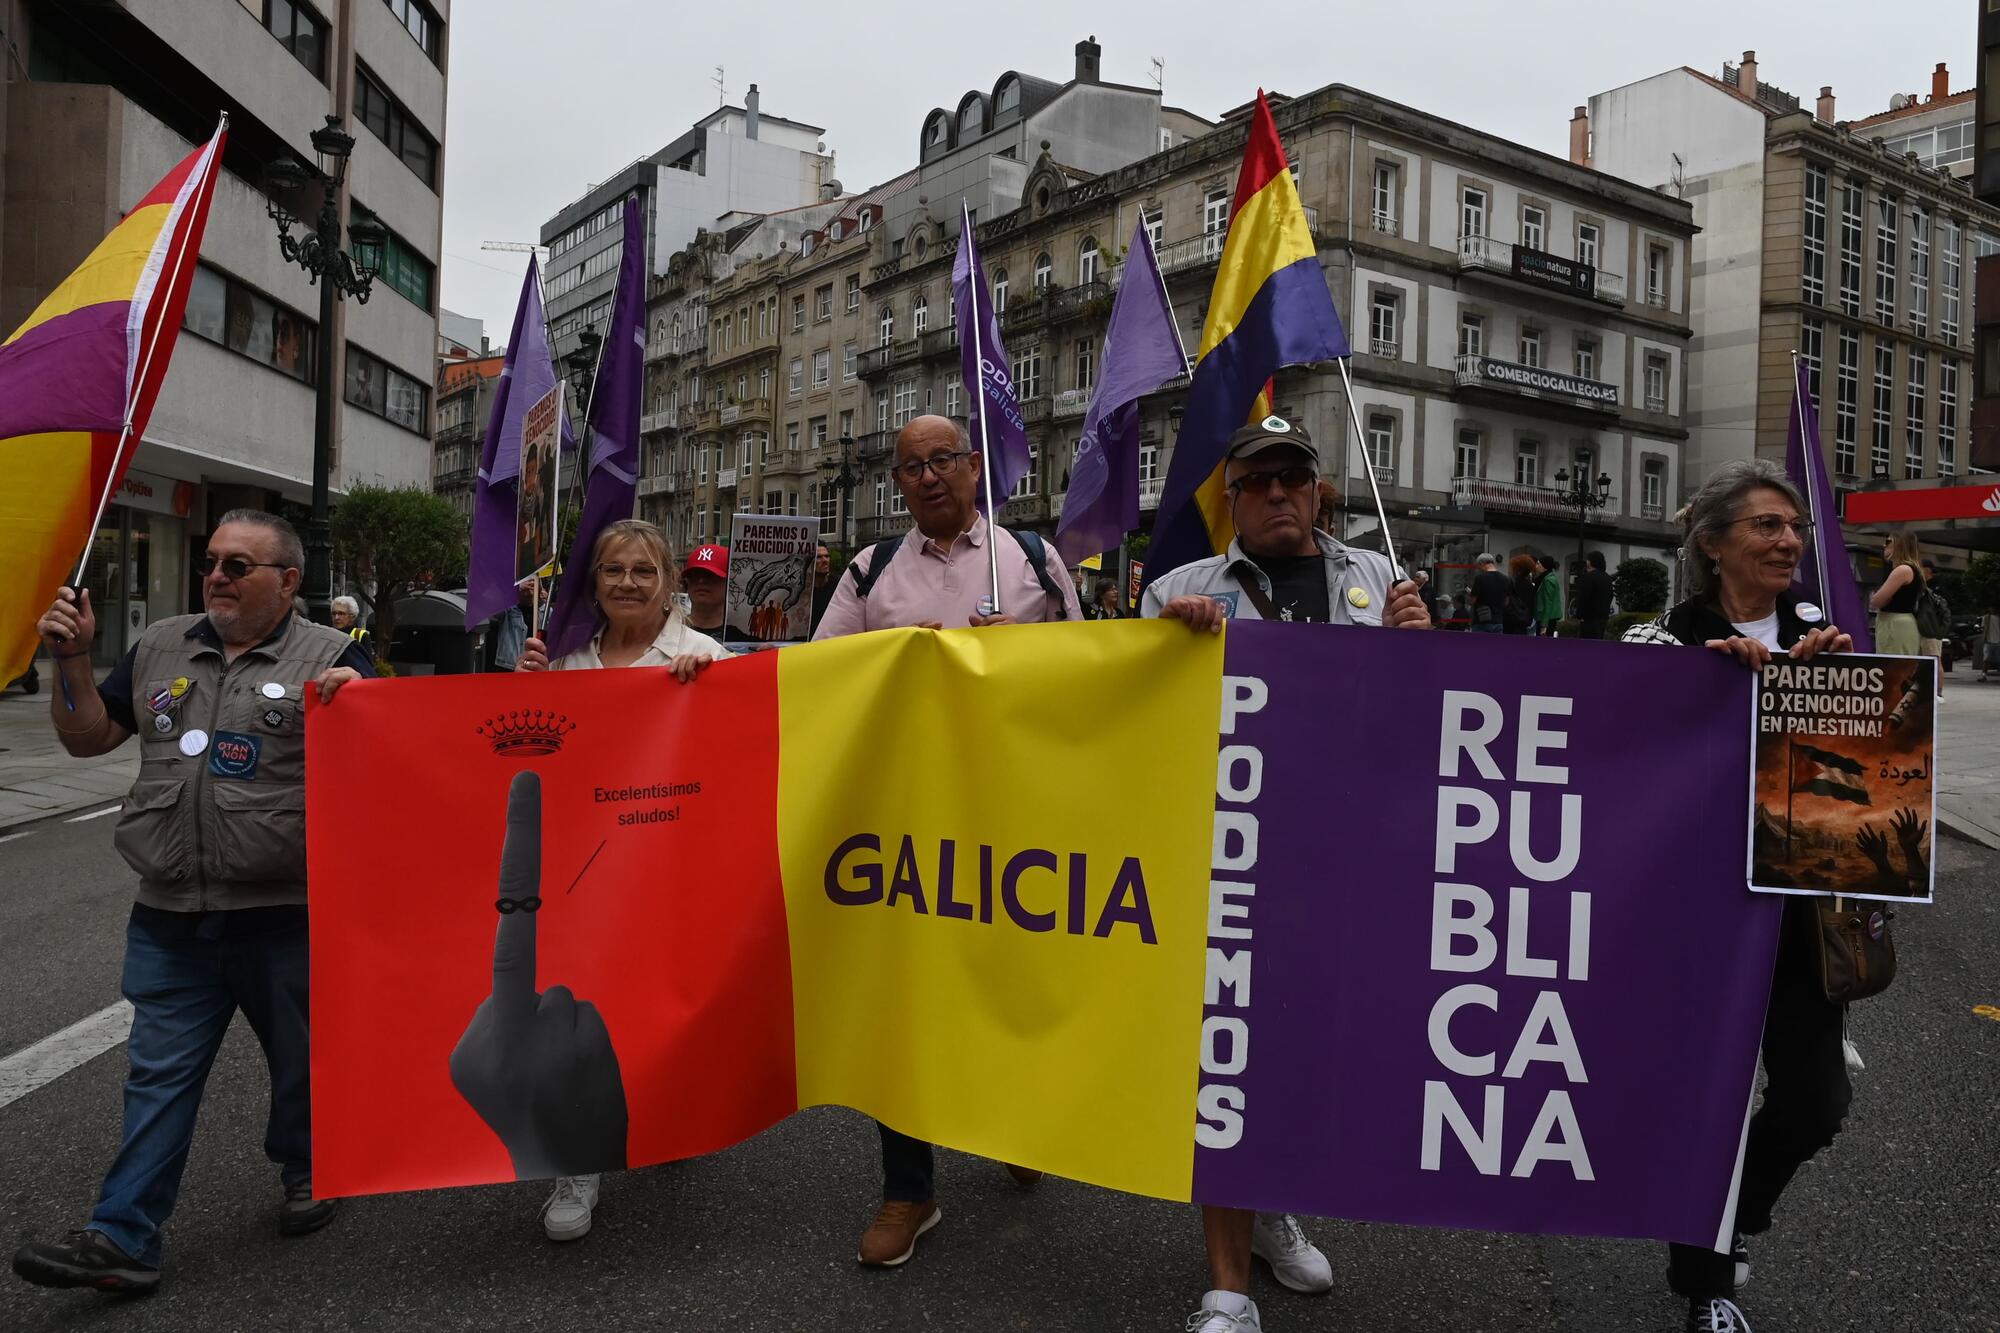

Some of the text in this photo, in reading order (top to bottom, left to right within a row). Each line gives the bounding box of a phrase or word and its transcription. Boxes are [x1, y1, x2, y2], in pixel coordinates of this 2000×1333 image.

[1487, 363, 1616, 401] COMERCIOGALLEGO.ES
[527, 392, 551, 427] PAREMOS
[982, 375, 1024, 432] Galicia
[734, 539, 816, 555] XENOCIDIO XA!
[743, 524, 808, 540] PAREMOS O
[697, 548, 713, 561] NY
[1763, 664, 1884, 693] PAREMOS
[1761, 692, 1884, 716] O XENOCIDIO
[1438, 689, 1573, 785] RE
[1761, 715, 1883, 738] EN PALESTINA!
[217, 741, 248, 753] OTAN
[222, 749, 248, 761] NON
[594, 781, 702, 803] Excelentísimos
[618, 805, 680, 826] saludos!
[1434, 785, 1582, 882] PU
[824, 832, 1158, 945] GALICIA
[1195, 675, 1268, 1149] PODEMOS
[1430, 882, 1591, 981] BLI
[1427, 983, 1589, 1083] CA
[1420, 1079, 1596, 1181] NA
